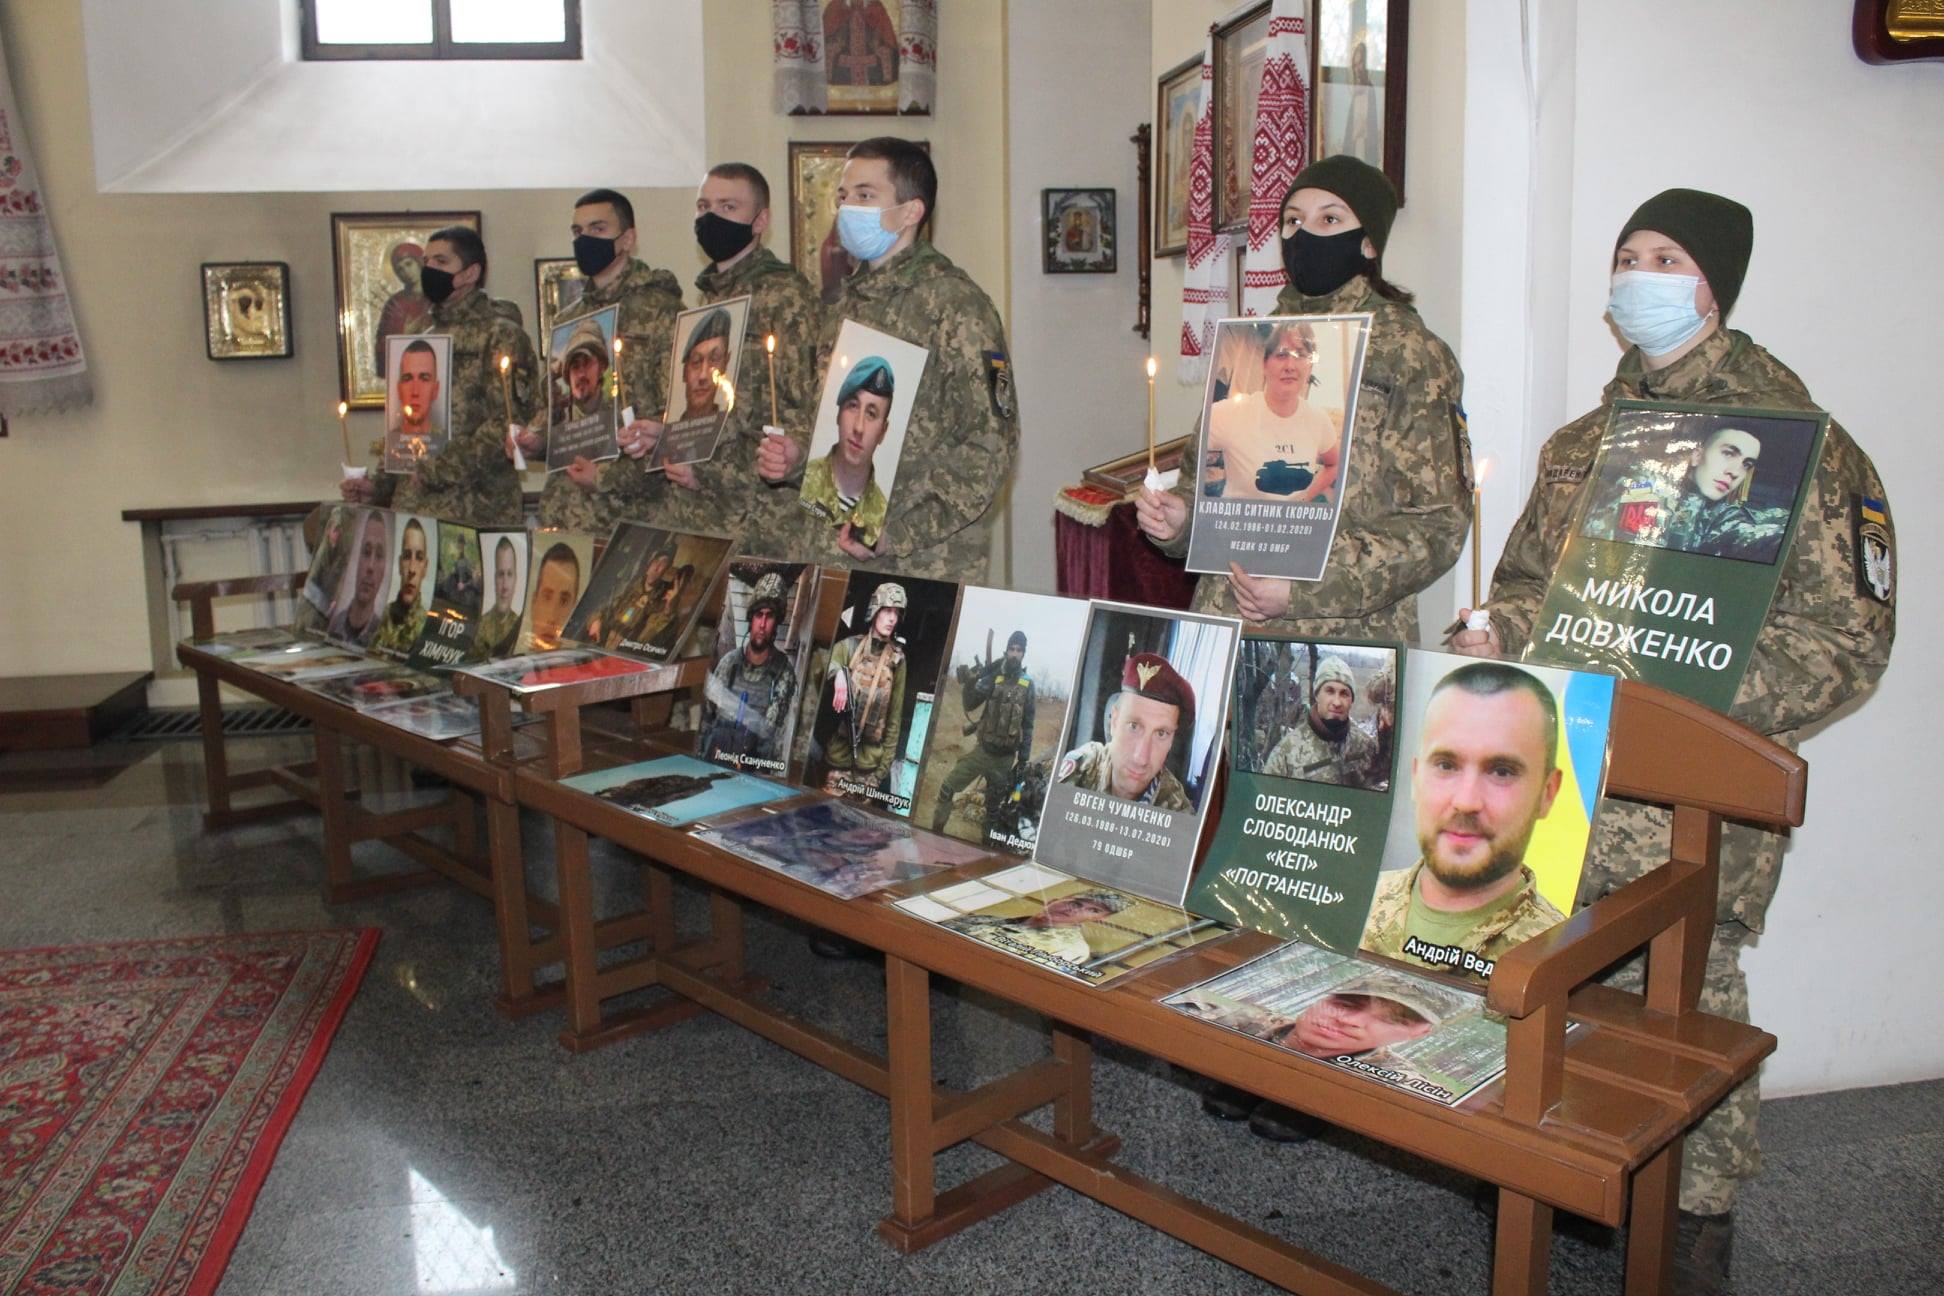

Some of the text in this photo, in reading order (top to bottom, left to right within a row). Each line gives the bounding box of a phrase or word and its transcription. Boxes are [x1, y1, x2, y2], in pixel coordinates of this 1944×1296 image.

[1199, 501, 1241, 517] КЛАВДІЯ
[1244, 505, 1281, 518] СИТНИК
[1230, 540, 1256, 552] МЕДИК
[1258, 542, 1268, 552] 93
[1581, 577, 1715, 625] МИКОЛА
[1545, 613, 1733, 671] ДОВЖЕНКО
[837, 778, 866, 796] Андрій
[1073, 791, 1173, 829] ЄВГЕН ЧУМАЧЕНКО
[1255, 793, 1352, 828] ОЛЕКСАНДР
[989, 828, 1007, 842] Іван
[1092, 839, 1103, 851] 79
[1243, 817, 1359, 855] СЛОБОДАНЮК
[1265, 849, 1319, 873] «КЕП»
[1225, 867, 1345, 906] «ПОГРАНЕЦЬ»
[1404, 936, 1460, 967] Андрій
[1336, 1055, 1405, 1083] Олексій
